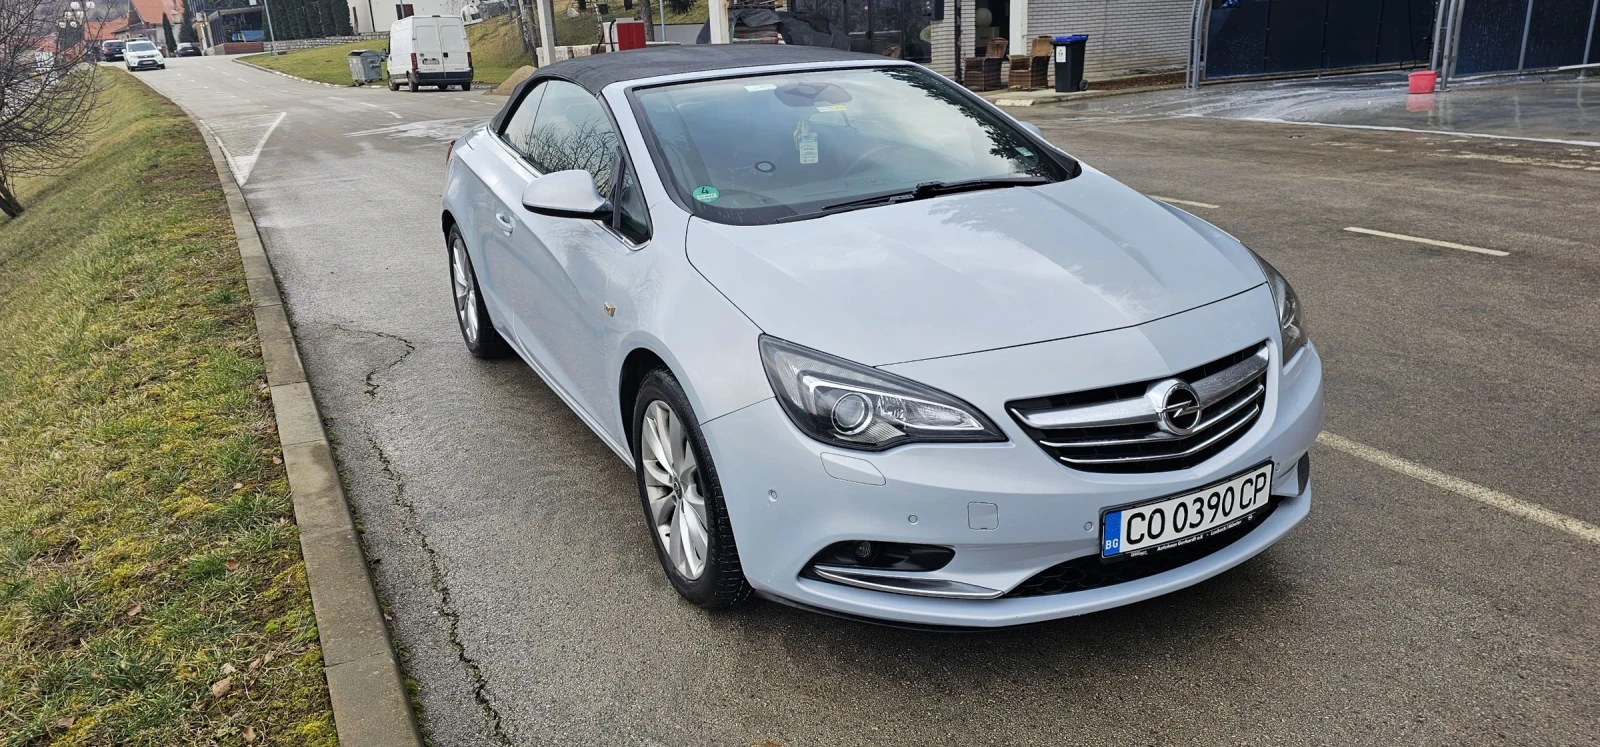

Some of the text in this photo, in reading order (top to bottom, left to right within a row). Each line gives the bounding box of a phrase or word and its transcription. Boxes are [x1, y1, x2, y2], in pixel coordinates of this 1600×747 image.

[701, 187, 709, 195] 4
[1126, 472, 1267, 546] CO 0390 CP
[1105, 538, 1119, 550] BG
